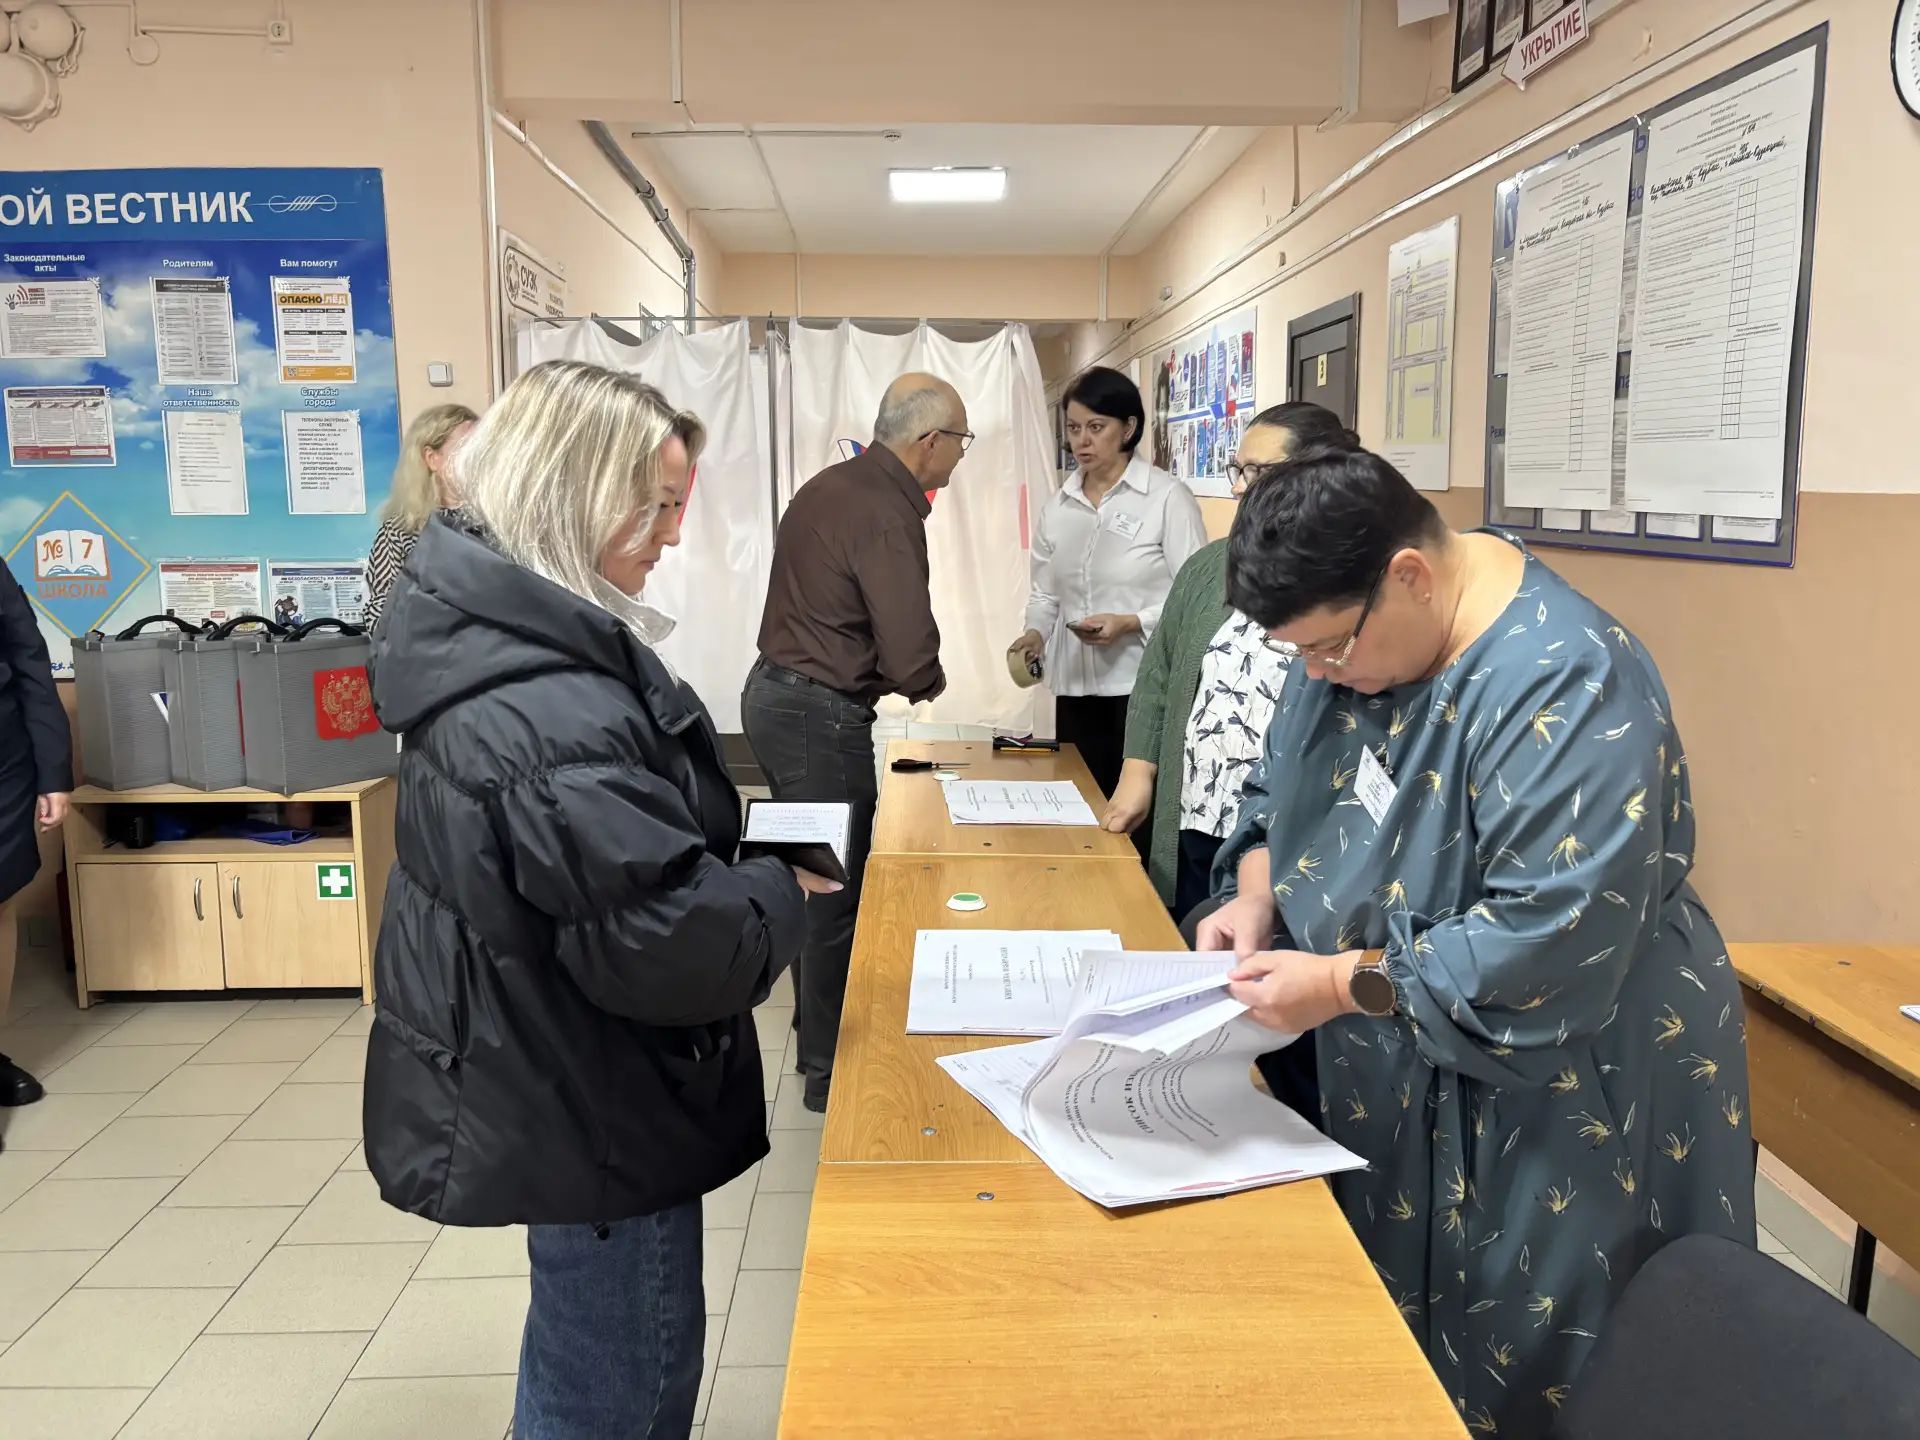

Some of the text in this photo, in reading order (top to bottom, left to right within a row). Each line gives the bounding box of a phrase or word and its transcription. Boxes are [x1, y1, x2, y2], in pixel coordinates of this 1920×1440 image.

[1521, 7, 1582, 70] УКРЫТИЕ
[66, 191, 254, 225] ВЕСТНИК
[3, 253, 86, 263] Законодательные
[34, 264, 57, 272] акты
[163, 259, 214, 269] Родителям
[280, 259, 339, 269] Вам помогут
[280, 295, 323, 304] ОПАСНО
[187, 387, 214, 396] Наша
[300, 387, 339, 397] Службы
[162, 399, 241, 408] ответственность
[304, 398, 336, 408] города
[42, 538, 93, 562] № 7
[37, 583, 109, 600] ШКОЛА
[1124, 1096, 1155, 1134] СПИСОК
